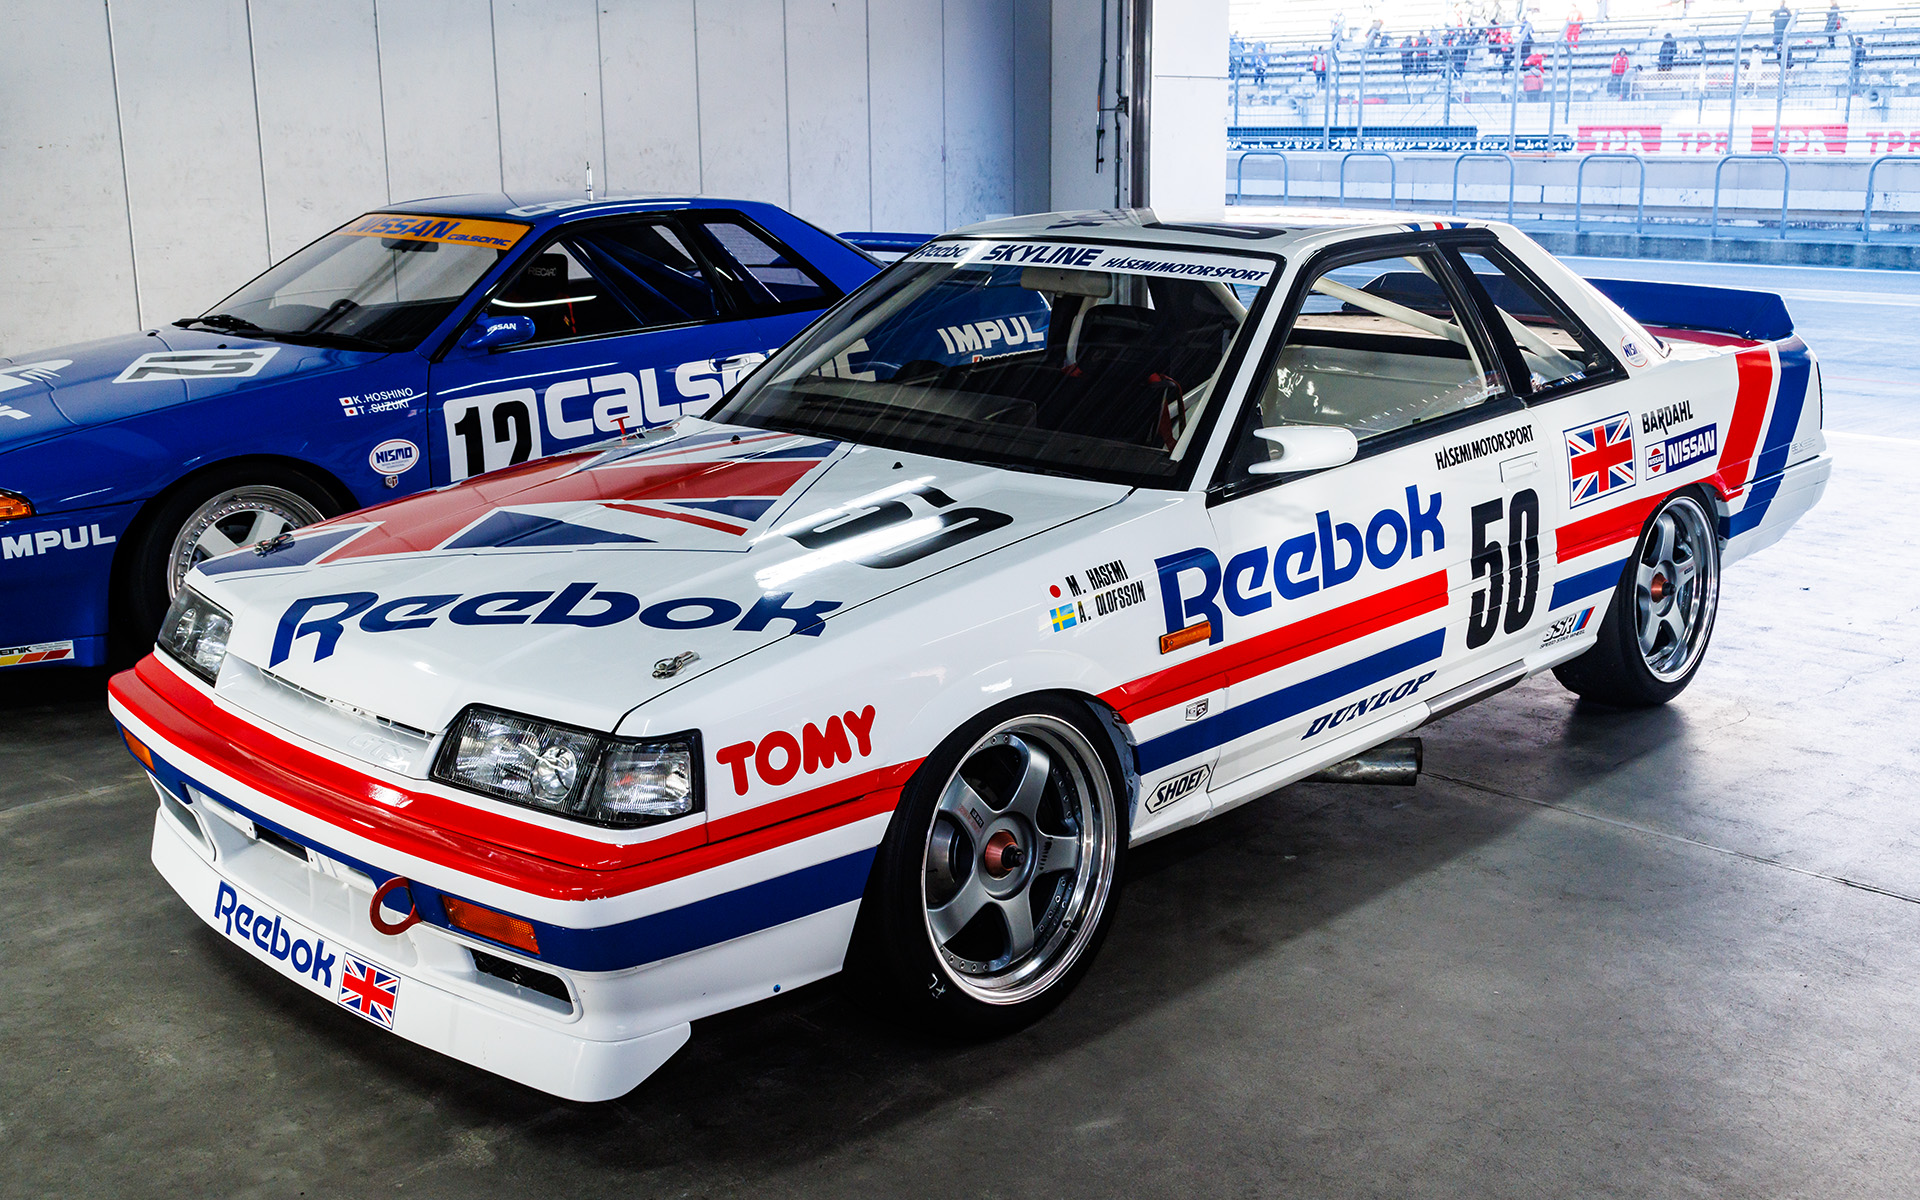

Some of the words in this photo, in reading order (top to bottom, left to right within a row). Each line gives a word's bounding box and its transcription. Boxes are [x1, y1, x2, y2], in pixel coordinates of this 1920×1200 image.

[357, 216, 461, 239] NISSAN
[913, 243, 973, 260] Reebo
[980, 244, 1105, 267] SKYLINE
[936, 315, 1045, 355] IMPUL
[1641, 399, 1693, 436] BARDAHL
[376, 447, 412, 464] NISMO
[454, 400, 533, 478] 12
[1667, 429, 1715, 467] NISSAN
[1065, 574, 1087, 597] M.
[1085, 559, 1129, 591] HASEMI
[1153, 484, 1446, 647] Reebok
[1466, 488, 1540, 650] 50
[1077, 600, 1091, 623] A.
[1095, 580, 1146, 616] OLOFSSON
[268, 582, 844, 669] Reebok
[1543, 613, 1577, 642] SSR
[1300, 669, 1437, 741] DUNLOP
[716, 704, 876, 796] TOMY
[1153, 769, 1205, 808] SHOEI
[214, 880, 336, 989] Reebok
